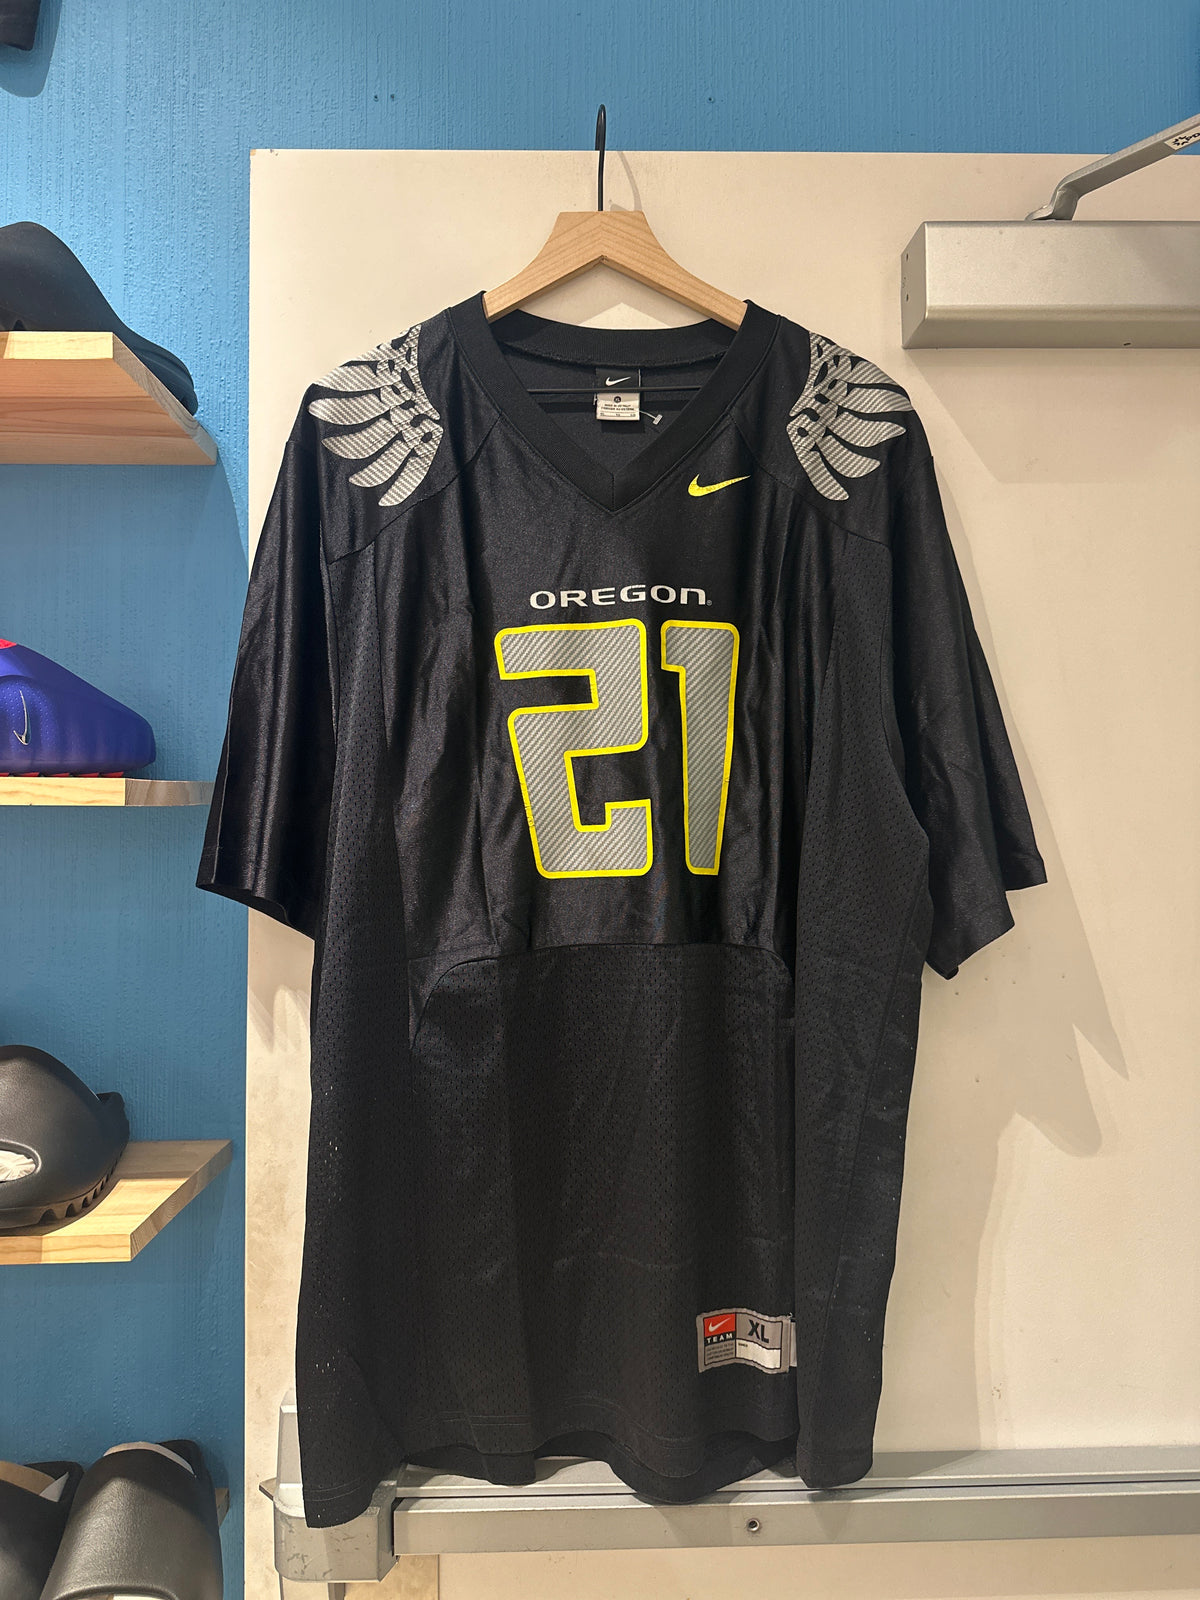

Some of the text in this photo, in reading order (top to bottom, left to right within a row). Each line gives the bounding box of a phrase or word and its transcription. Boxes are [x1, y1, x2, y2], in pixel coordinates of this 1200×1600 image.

[494, 618, 740, 879] 21
[706, 1332, 733, 1344] TEAM
[748, 1319, 770, 1344] XL
